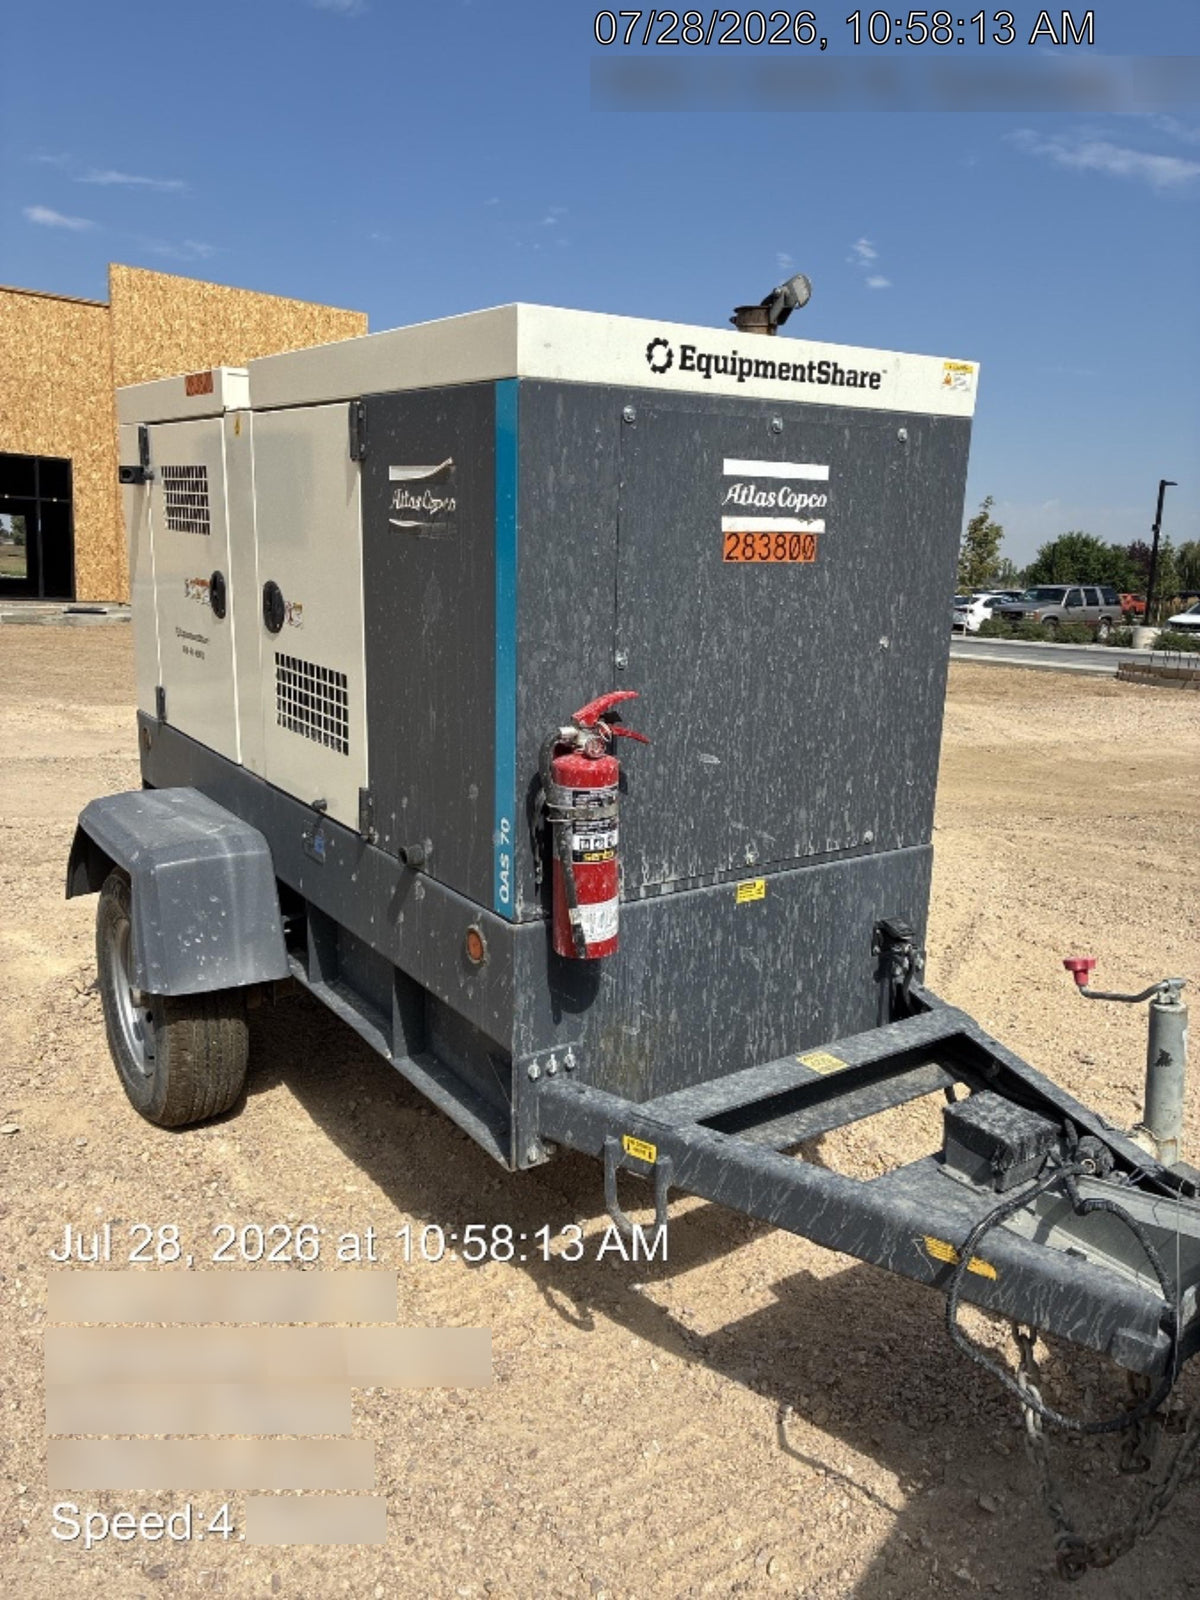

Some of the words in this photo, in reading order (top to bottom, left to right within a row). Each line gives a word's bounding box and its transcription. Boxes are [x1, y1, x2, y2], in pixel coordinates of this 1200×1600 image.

[679, 344, 882, 391] EquipmentShare
[724, 533, 816, 561] 283800
[499, 816, 511, 845] 70
[499, 852, 511, 904] QAS
